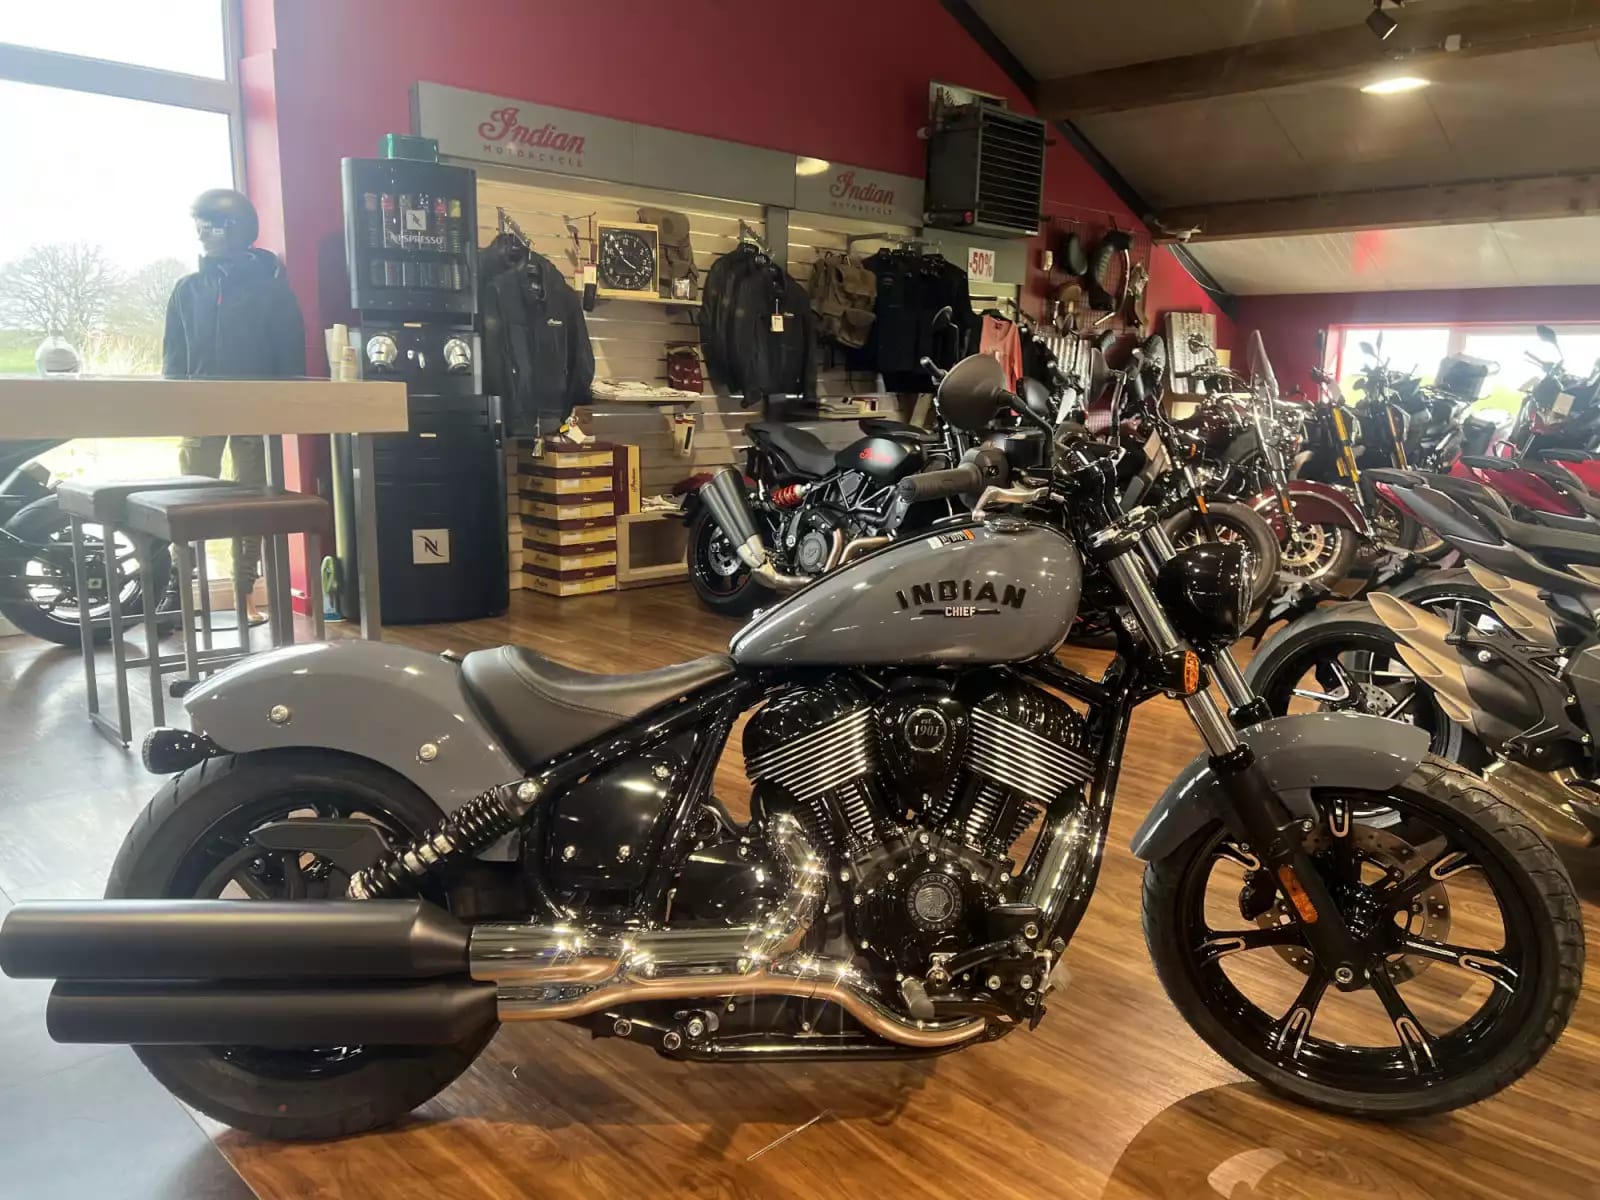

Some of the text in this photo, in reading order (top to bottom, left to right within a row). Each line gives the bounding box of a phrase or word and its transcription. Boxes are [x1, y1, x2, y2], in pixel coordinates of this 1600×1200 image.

[478, 106, 585, 154] Indian
[830, 171, 894, 205] Indian
[969, 251, 993, 277] -50%
[895, 579, 1027, 610] INDIAN
[945, 606, 976, 617] CHIEF
[914, 724, 940, 737] 1901
